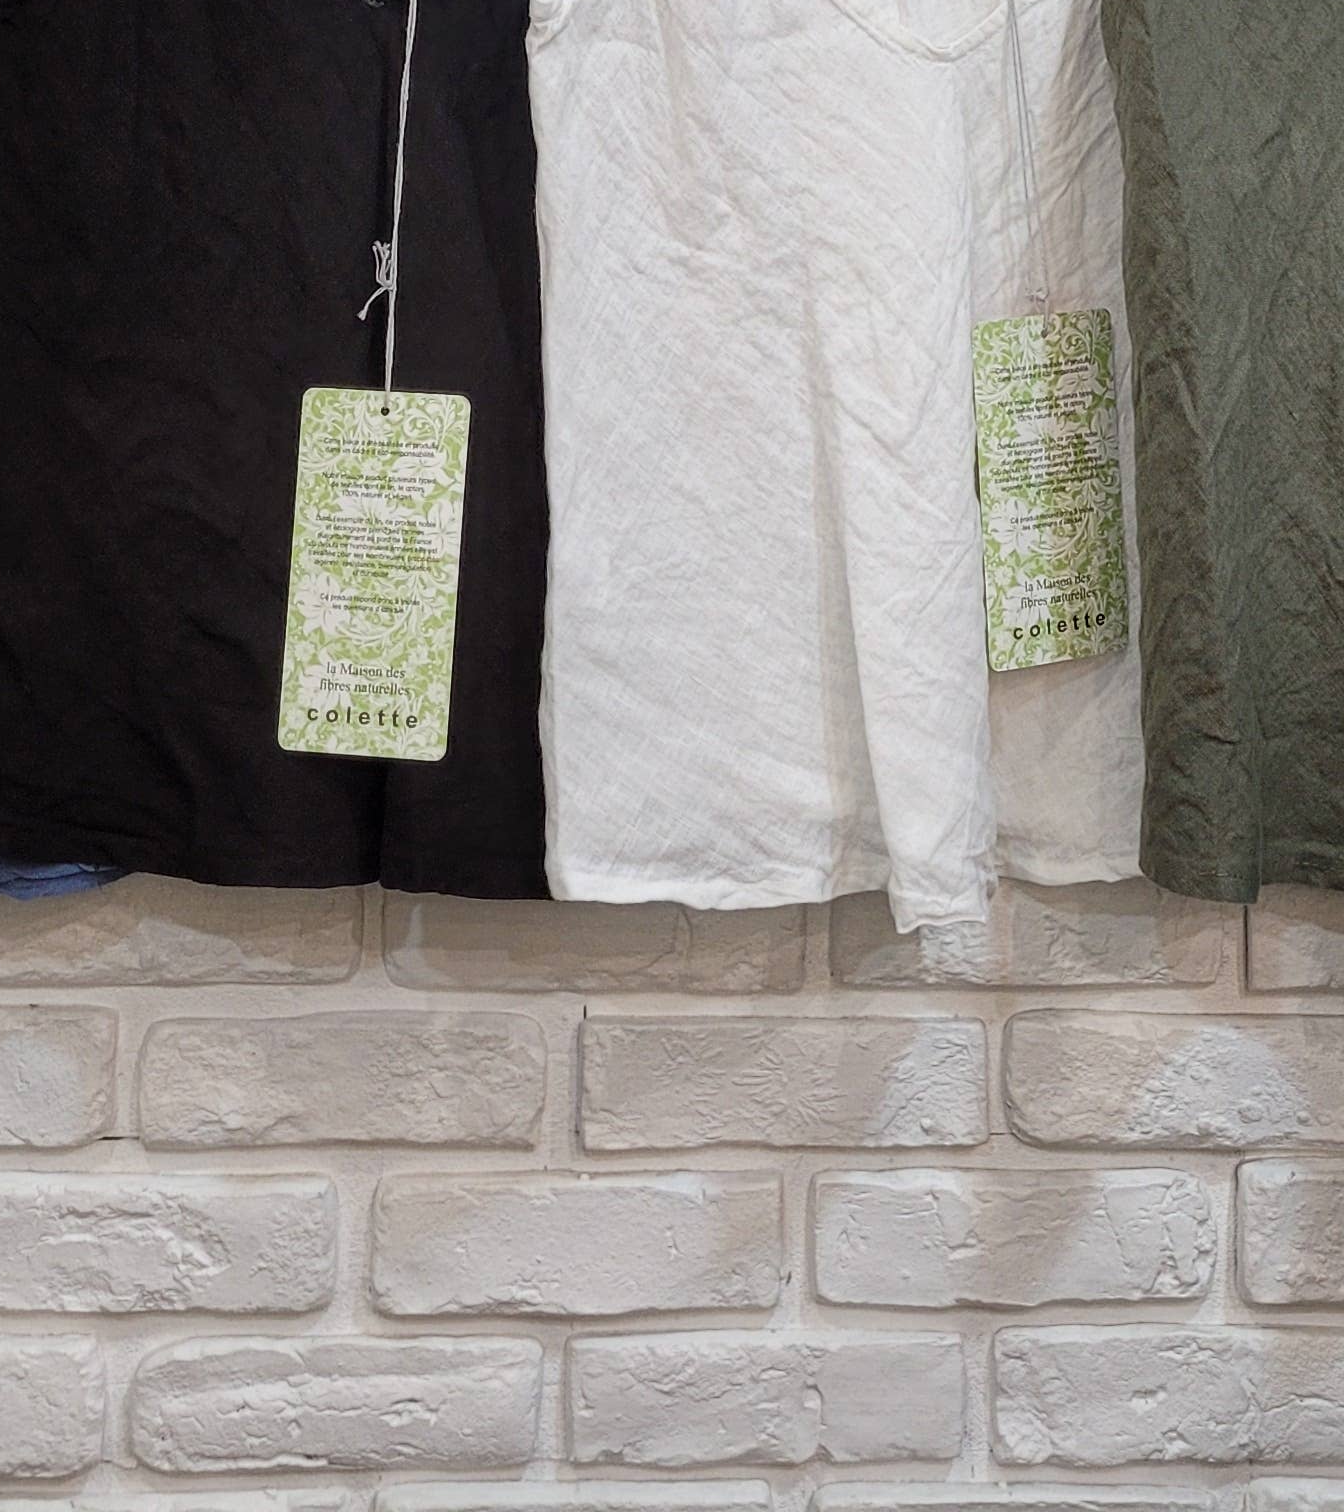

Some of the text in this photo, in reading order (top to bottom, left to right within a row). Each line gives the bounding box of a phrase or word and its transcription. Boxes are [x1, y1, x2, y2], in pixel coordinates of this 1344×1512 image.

[1024, 572, 1091, 592] la Maison des
[1020, 587, 1097, 608] fibres naturelles
[1013, 612, 1106, 640] colette
[326, 662, 406, 679] la Maison des
[319, 678, 410, 696] fibres naturelles
[307, 706, 418, 729] colette
